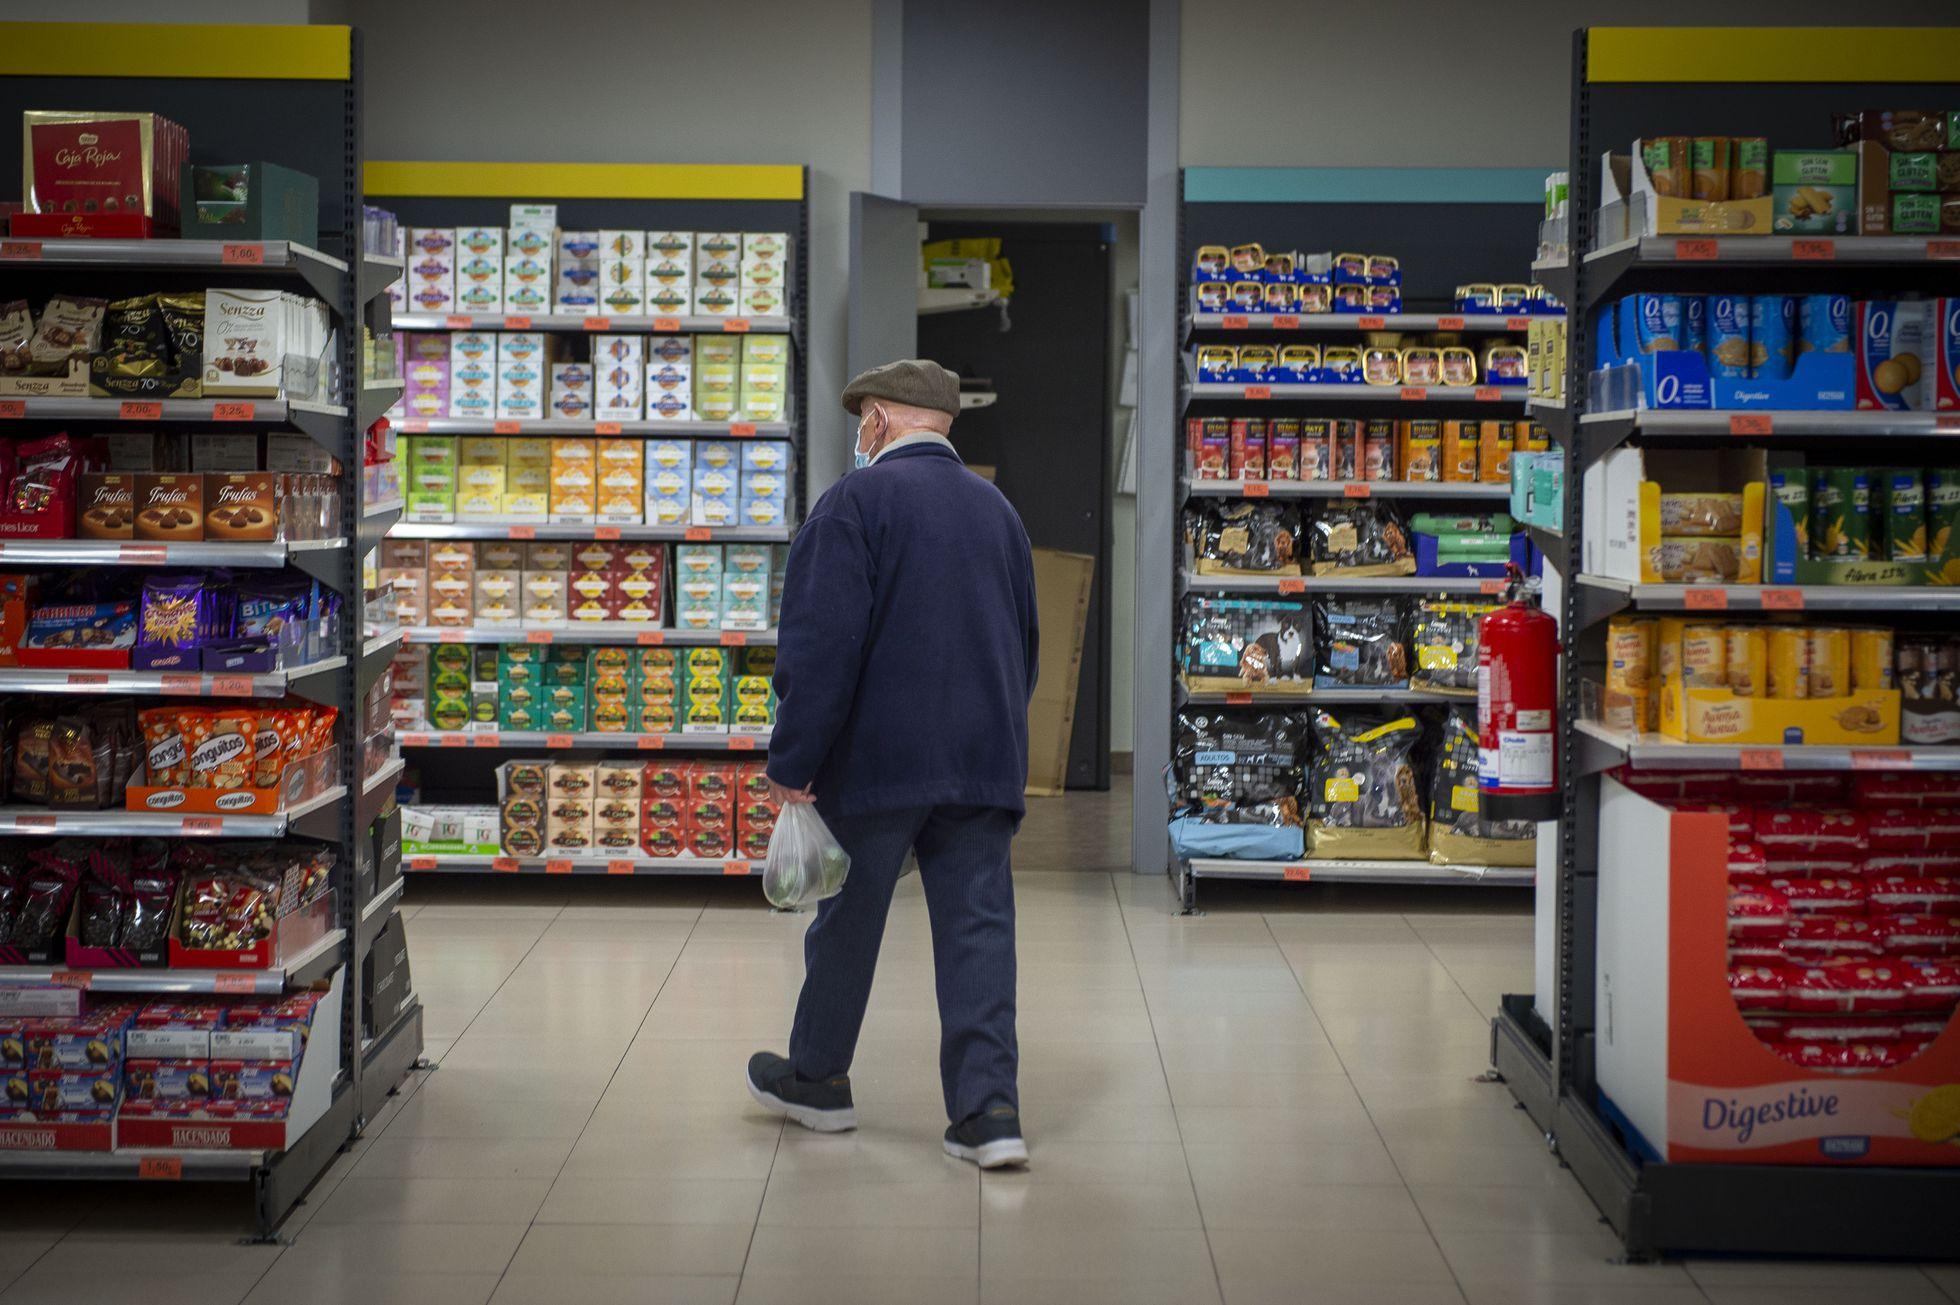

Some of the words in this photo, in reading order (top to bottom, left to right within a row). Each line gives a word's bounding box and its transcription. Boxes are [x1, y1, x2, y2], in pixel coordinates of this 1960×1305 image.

[55, 149, 82, 169] Caja
[82, 146, 121, 168] Roja
[219, 303, 265, 317] Senzza
[15, 380, 50, 392] Senzza
[105, 376, 139, 390] Senzza
[94, 486, 133, 504] Trufas
[149, 486, 188, 504] Trufas
[218, 485, 257, 504] Trufas
[18, 521, 40, 533] Licor
[148, 793, 185, 807] conguitos
[217, 794, 254, 808] conguitos
[1702, 1088, 1839, 1143] Digestive
[172, 1128, 230, 1149] HACENDADO
